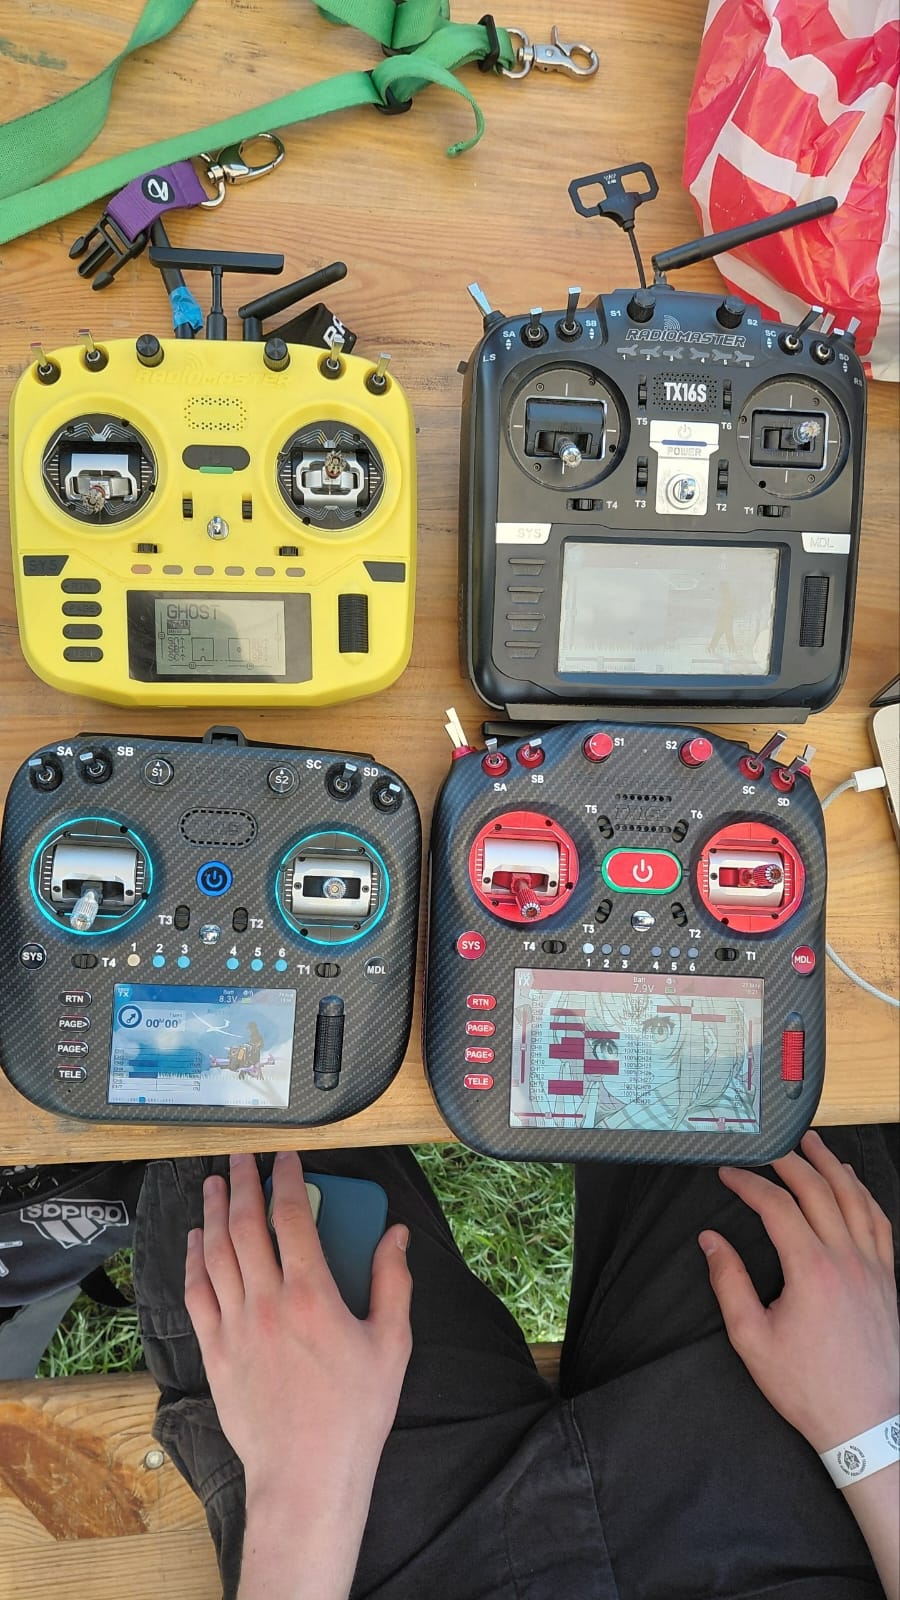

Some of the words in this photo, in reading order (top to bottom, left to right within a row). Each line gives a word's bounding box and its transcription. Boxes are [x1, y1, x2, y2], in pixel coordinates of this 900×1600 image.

[610, 309, 622, 317] S1
[585, 319, 598, 328] SB
[747, 318, 759, 327] S2
[502, 330, 517, 339] SA
[625, 328, 747, 348] RADIOMASTER
[764, 329, 777, 338] SC
[482, 353, 497, 363] LS
[663, 381, 707, 403] TX16S
[636, 417, 649, 426] T5
[720, 422, 733, 431] T6
[666, 446, 702, 458] POWER
[605, 500, 619, 510] T4
[634, 499, 647, 509] T3
[716, 503, 728, 513] T2
[743, 506, 754, 516] T1
[517, 527, 542, 539] SYS
[809, 536, 835, 549] MDL
[29, 559, 58, 572] SYS
[166, 603, 220, 620] GHOST
[614, 737, 625, 747] S1
[665, 740, 678, 750] S2
[56, 745, 74, 757] SA
[116, 746, 134, 757] SB
[305, 759, 322, 770] SC
[151, 768, 163, 777] S1
[363, 766, 379, 777] SD
[274, 775, 289, 785] S2
[531, 774, 545, 784] SB
[493, 782, 508, 792] SA
[742, 785, 756, 795] SC
[777, 798, 790, 807] SD
[585, 804, 598, 814] T5
[690, 810, 704, 819] T6
[158, 914, 173, 926] T3
[250, 918, 264, 929] T2
[582, 923, 595, 934] T3
[689, 929, 701, 939] T2
[131, 942, 137, 952] 1
[156, 944, 163, 953] 2
[181, 944, 188, 954] 3
[461, 940, 481, 950] SYS
[523, 941, 536, 951] T4
[229, 946, 238, 956] 4
[254, 947, 262, 957] 5
[278, 948, 286, 958] 6
[745, 951, 756, 961] T1
[21, 952, 43, 962] SYS
[794, 955, 812, 965] MDL
[101, 957, 116, 968] T4
[586, 958, 592, 967] 1
[603, 959, 610, 968] 2
[621, 960, 628, 969] 3
[652, 961, 660, 970] 4
[671, 962, 678, 971] 5
[689, 962, 696, 972] 6
[297, 964, 311, 975] T1
[366, 965, 387, 975] MDL
[633, 983, 654, 993] 7.9V
[65, 994, 84, 1003] RTN
[218, 995, 238, 1003] 8.3V
[472, 998, 489, 1007] RTN
[58, 1070, 82, 1079] TELE
[467, 1077, 489, 1086] TELE
